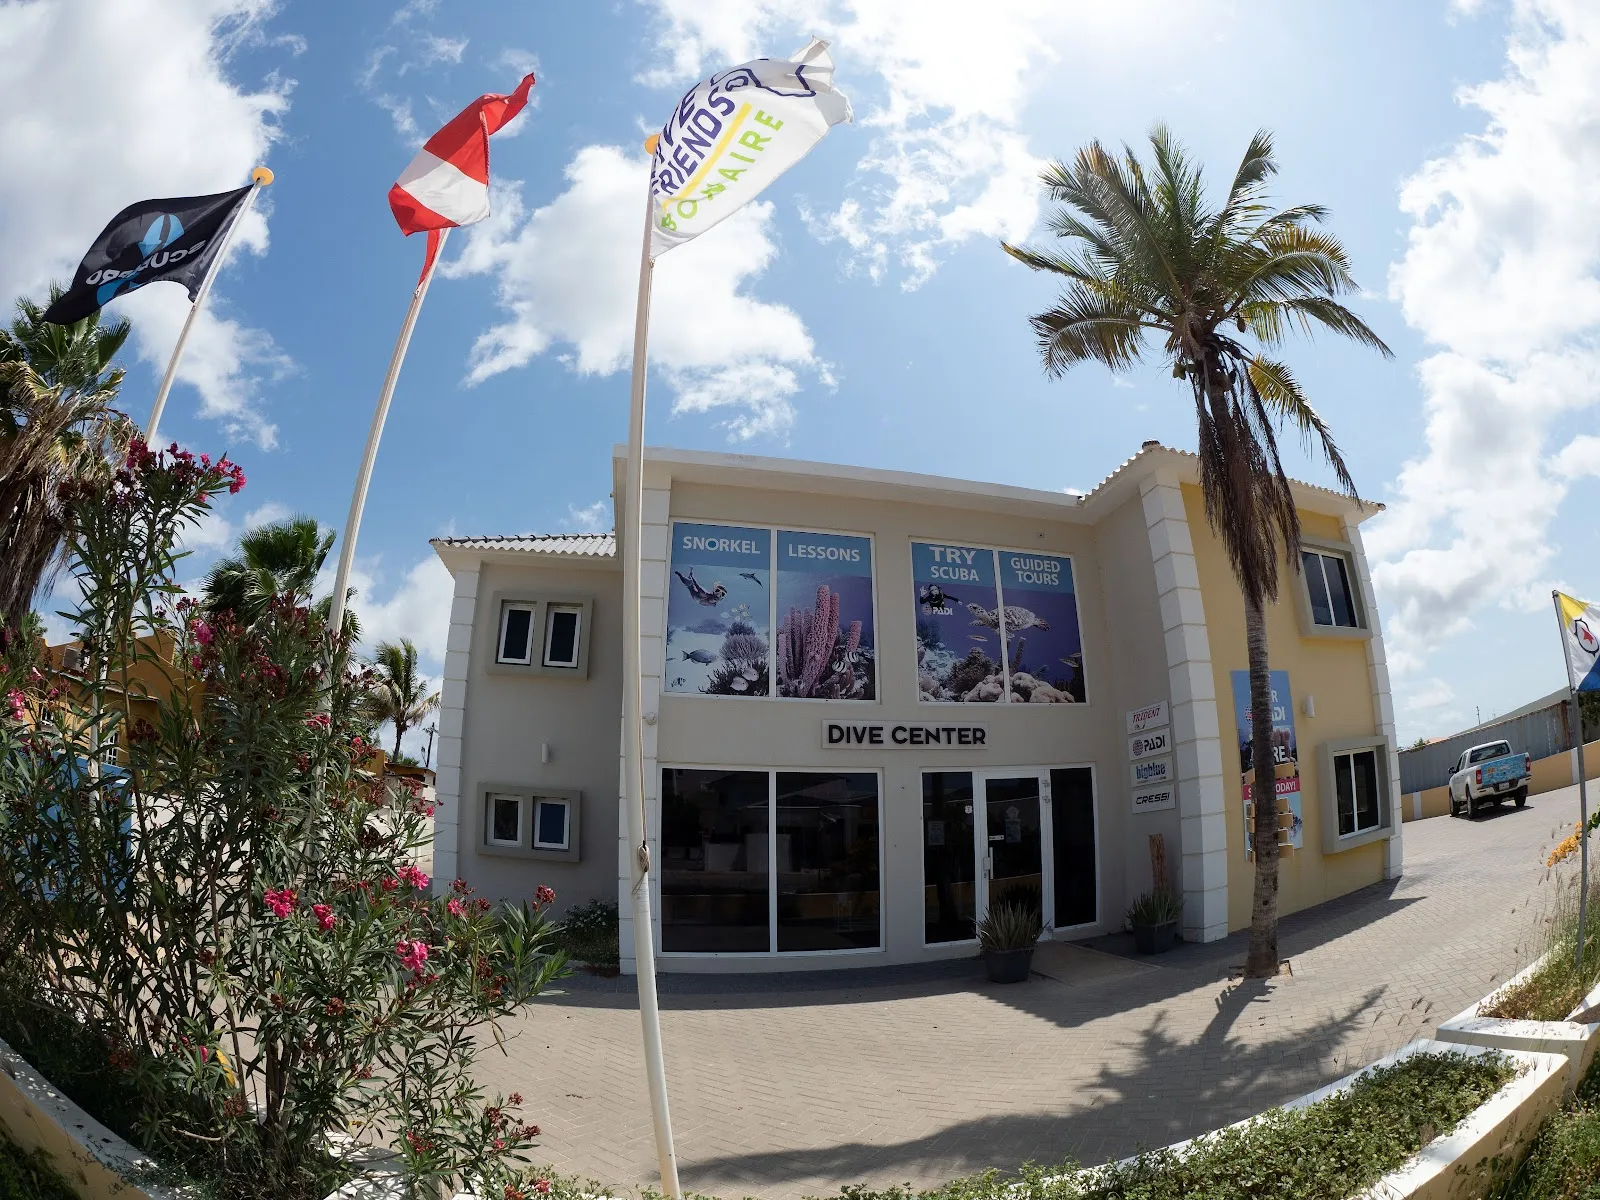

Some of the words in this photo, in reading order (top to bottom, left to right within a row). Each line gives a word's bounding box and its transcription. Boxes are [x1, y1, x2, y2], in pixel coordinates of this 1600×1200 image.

[682, 535, 761, 555] SNORKEL
[788, 543, 861, 563] LESSONS
[929, 546, 978, 566] TRY
[930, 565, 980, 583] SCUBA
[1010, 557, 1062, 574] GUIDED
[1015, 570, 1060, 587] TOURS
[932, 606, 953, 616] PADI
[1132, 707, 1161, 723] TRIDENT
[828, 724, 884, 744] DIVE
[890, 725, 987, 746] CENTER
[1143, 735, 1166, 752] PADI
[1136, 762, 1166, 779] bigblue
[1275, 780, 1297, 794] ODAY!
[1135, 791, 1171, 805] CRESSI
